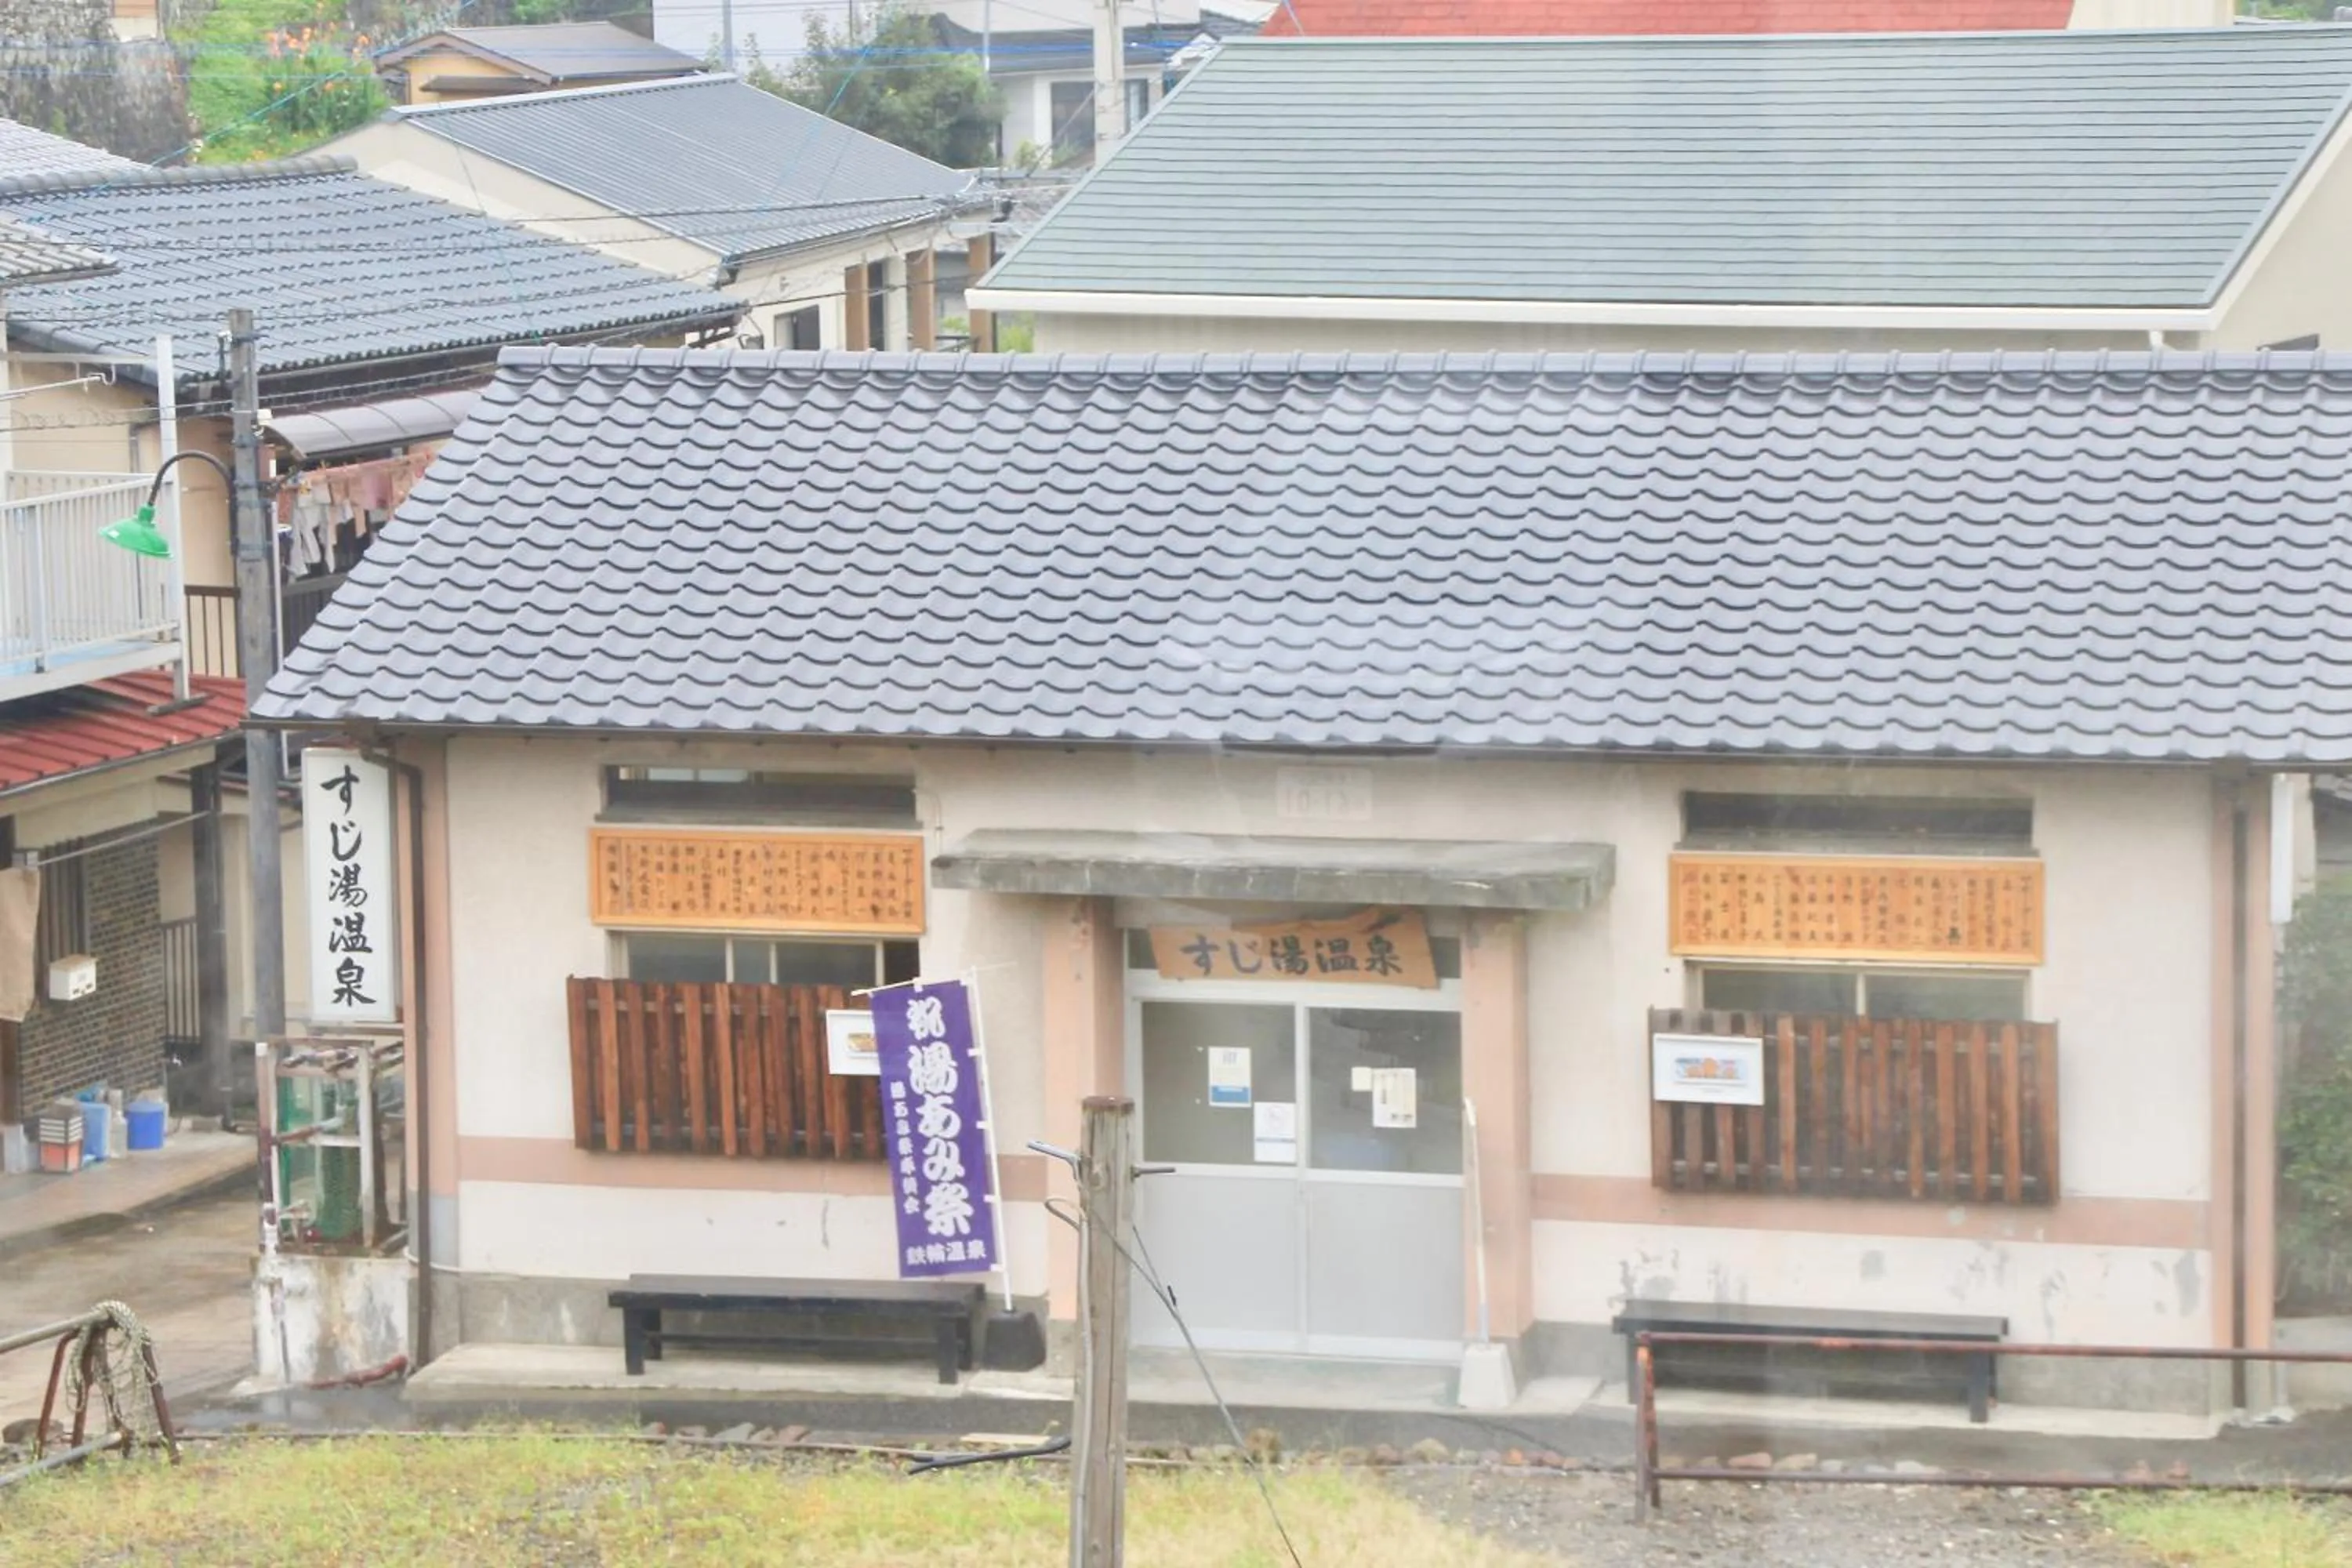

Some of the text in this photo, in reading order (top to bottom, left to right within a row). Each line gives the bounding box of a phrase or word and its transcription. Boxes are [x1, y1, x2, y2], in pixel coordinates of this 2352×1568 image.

[320, 764, 377, 1007] すじ湯温泉
[1180, 933, 1403, 977] すじ湯温泉
